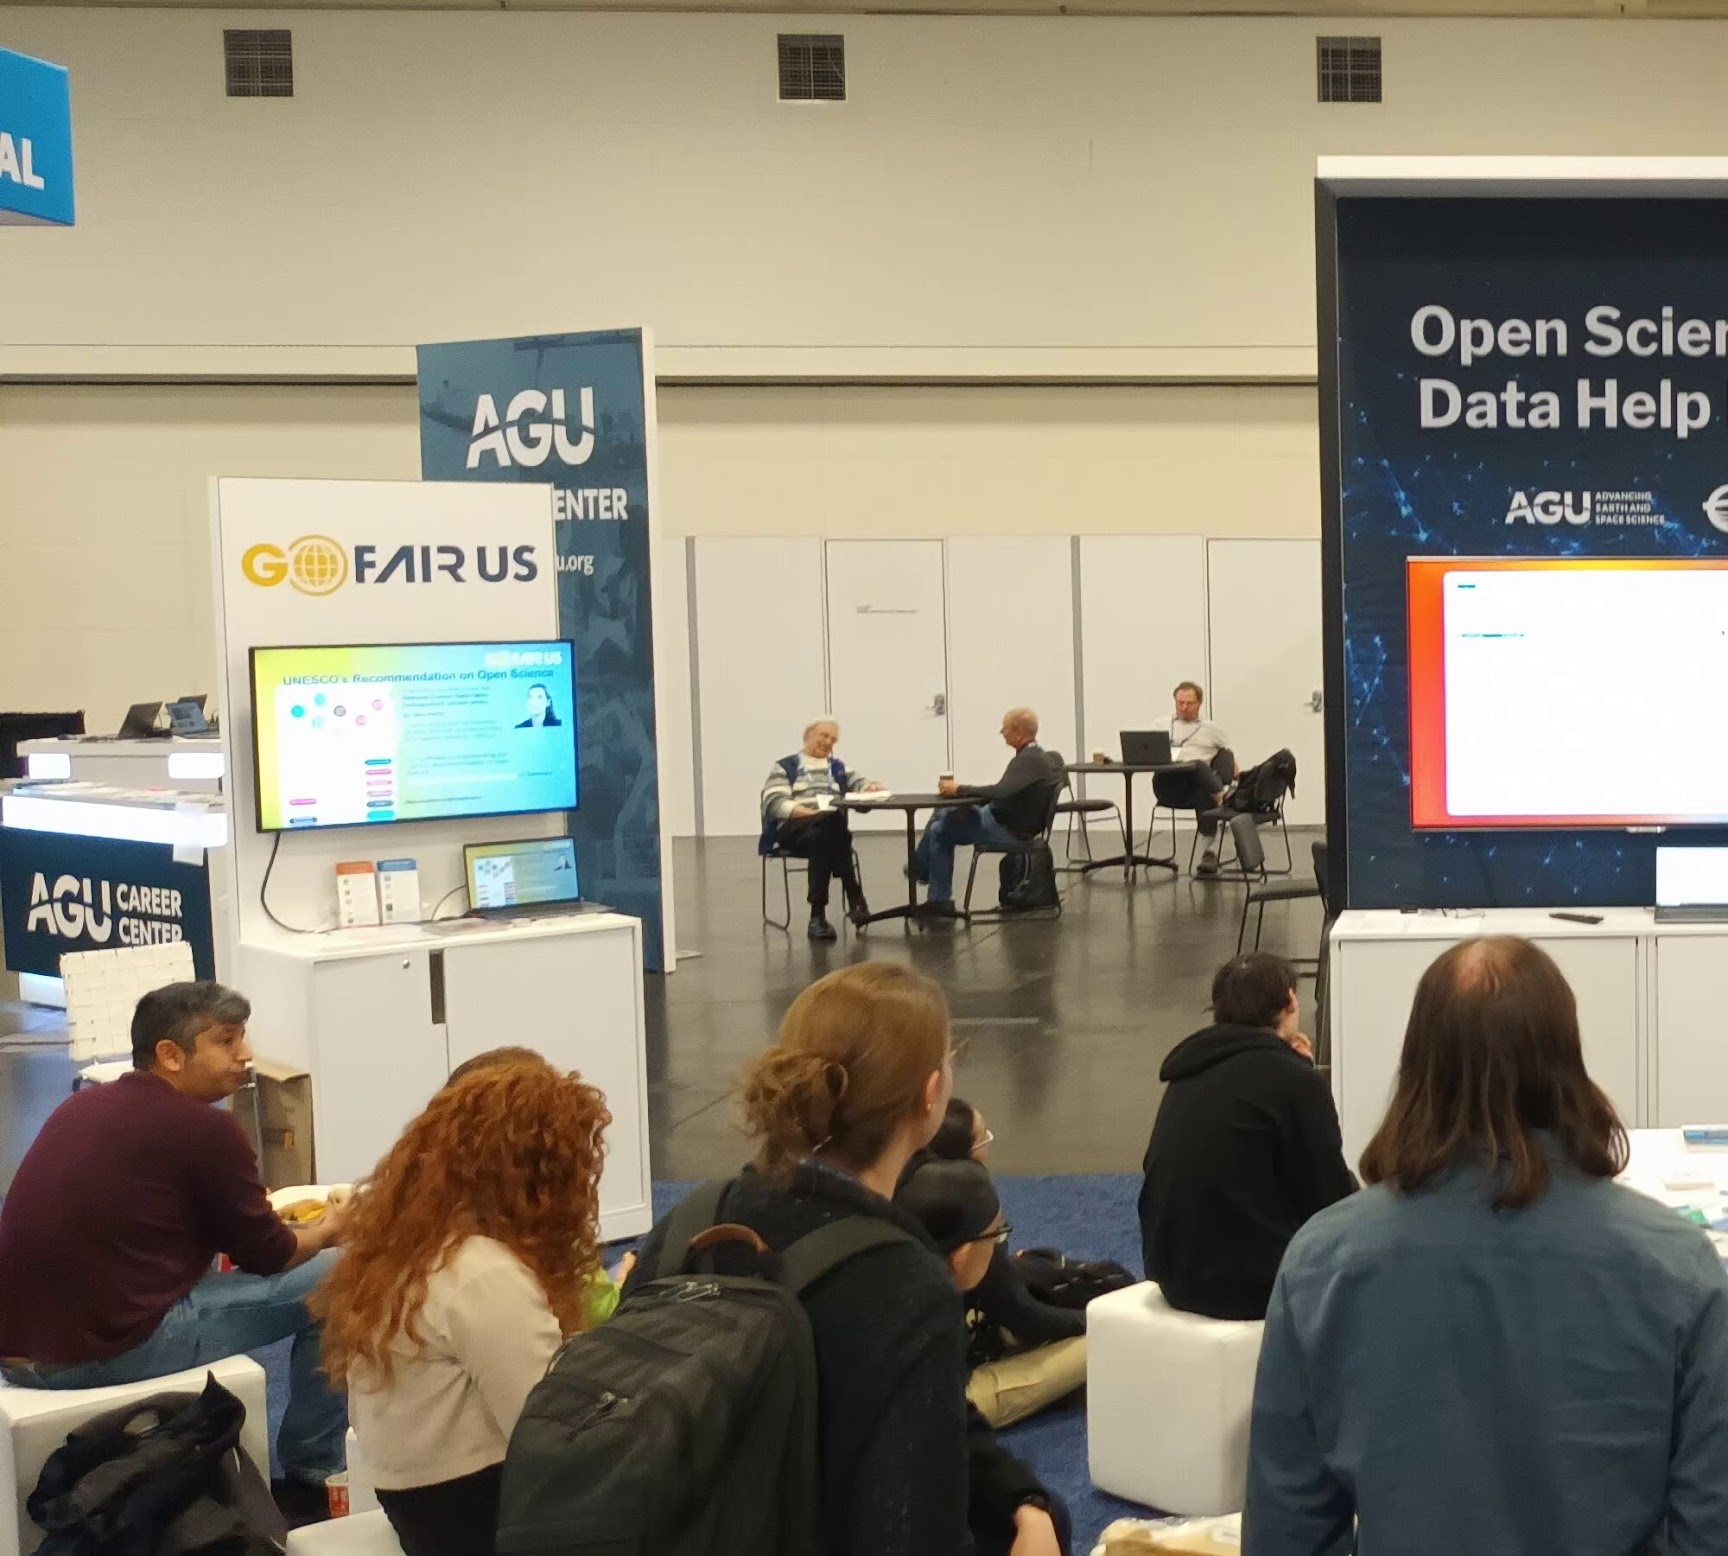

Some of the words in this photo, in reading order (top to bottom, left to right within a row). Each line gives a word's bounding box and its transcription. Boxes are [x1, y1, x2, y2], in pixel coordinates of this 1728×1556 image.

[1410, 305, 1568, 366] Open
[1419, 378, 1560, 429] Data
[1577, 378, 1711, 439] Help
[466, 386, 595, 469] AGU
[554, 487, 629, 521] ENTER
[1504, 490, 1592, 525] AGU
[1595, 491, 1652, 501] ADVANCING
[1595, 502, 1629, 513] EARTH
[1629, 502, 1652, 513] AND
[1595, 514, 1625, 525] SPACE
[1625, 514, 1666, 525] SCIENCE
[353, 544, 467, 584] FAIR
[476, 544, 538, 583] US
[556, 555, 595, 576] u.org
[353, 671, 456, 683] Recommendation
[460, 673, 474, 681] on
[477, 669, 507, 681] Open
[27, 872, 112, 943] AGU
[116, 883, 183, 918] CAREER
[118, 917, 183, 945] CENTER
